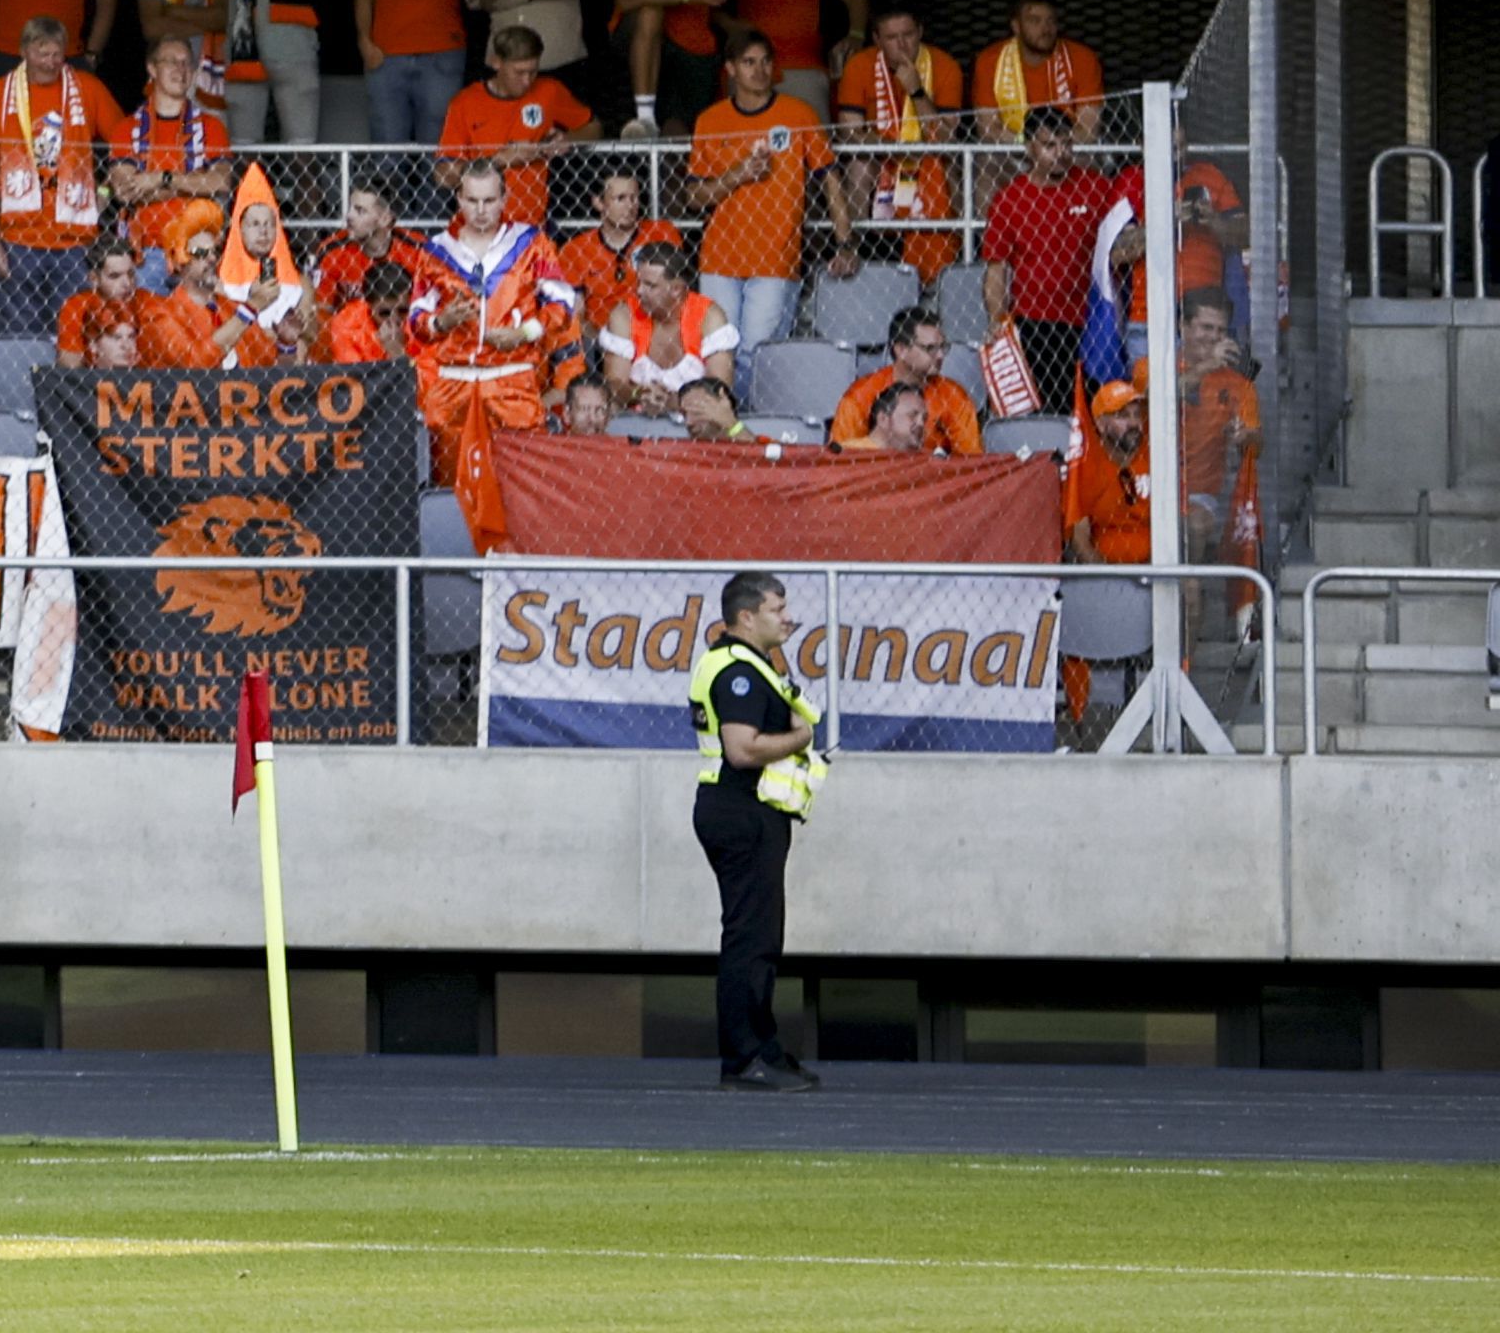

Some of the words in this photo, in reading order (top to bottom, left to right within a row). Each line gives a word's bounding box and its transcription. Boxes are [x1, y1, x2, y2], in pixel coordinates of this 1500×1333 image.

[94, 376, 367, 429] MARCO
[97, 429, 365, 479] STERKTE
[111, 649, 234, 678] YOU'LL
[245, 646, 370, 677] NEVER
[497, 588, 1057, 689] Stadanaal
[114, 683, 222, 712] WALK
[269, 679, 372, 711] LONE
